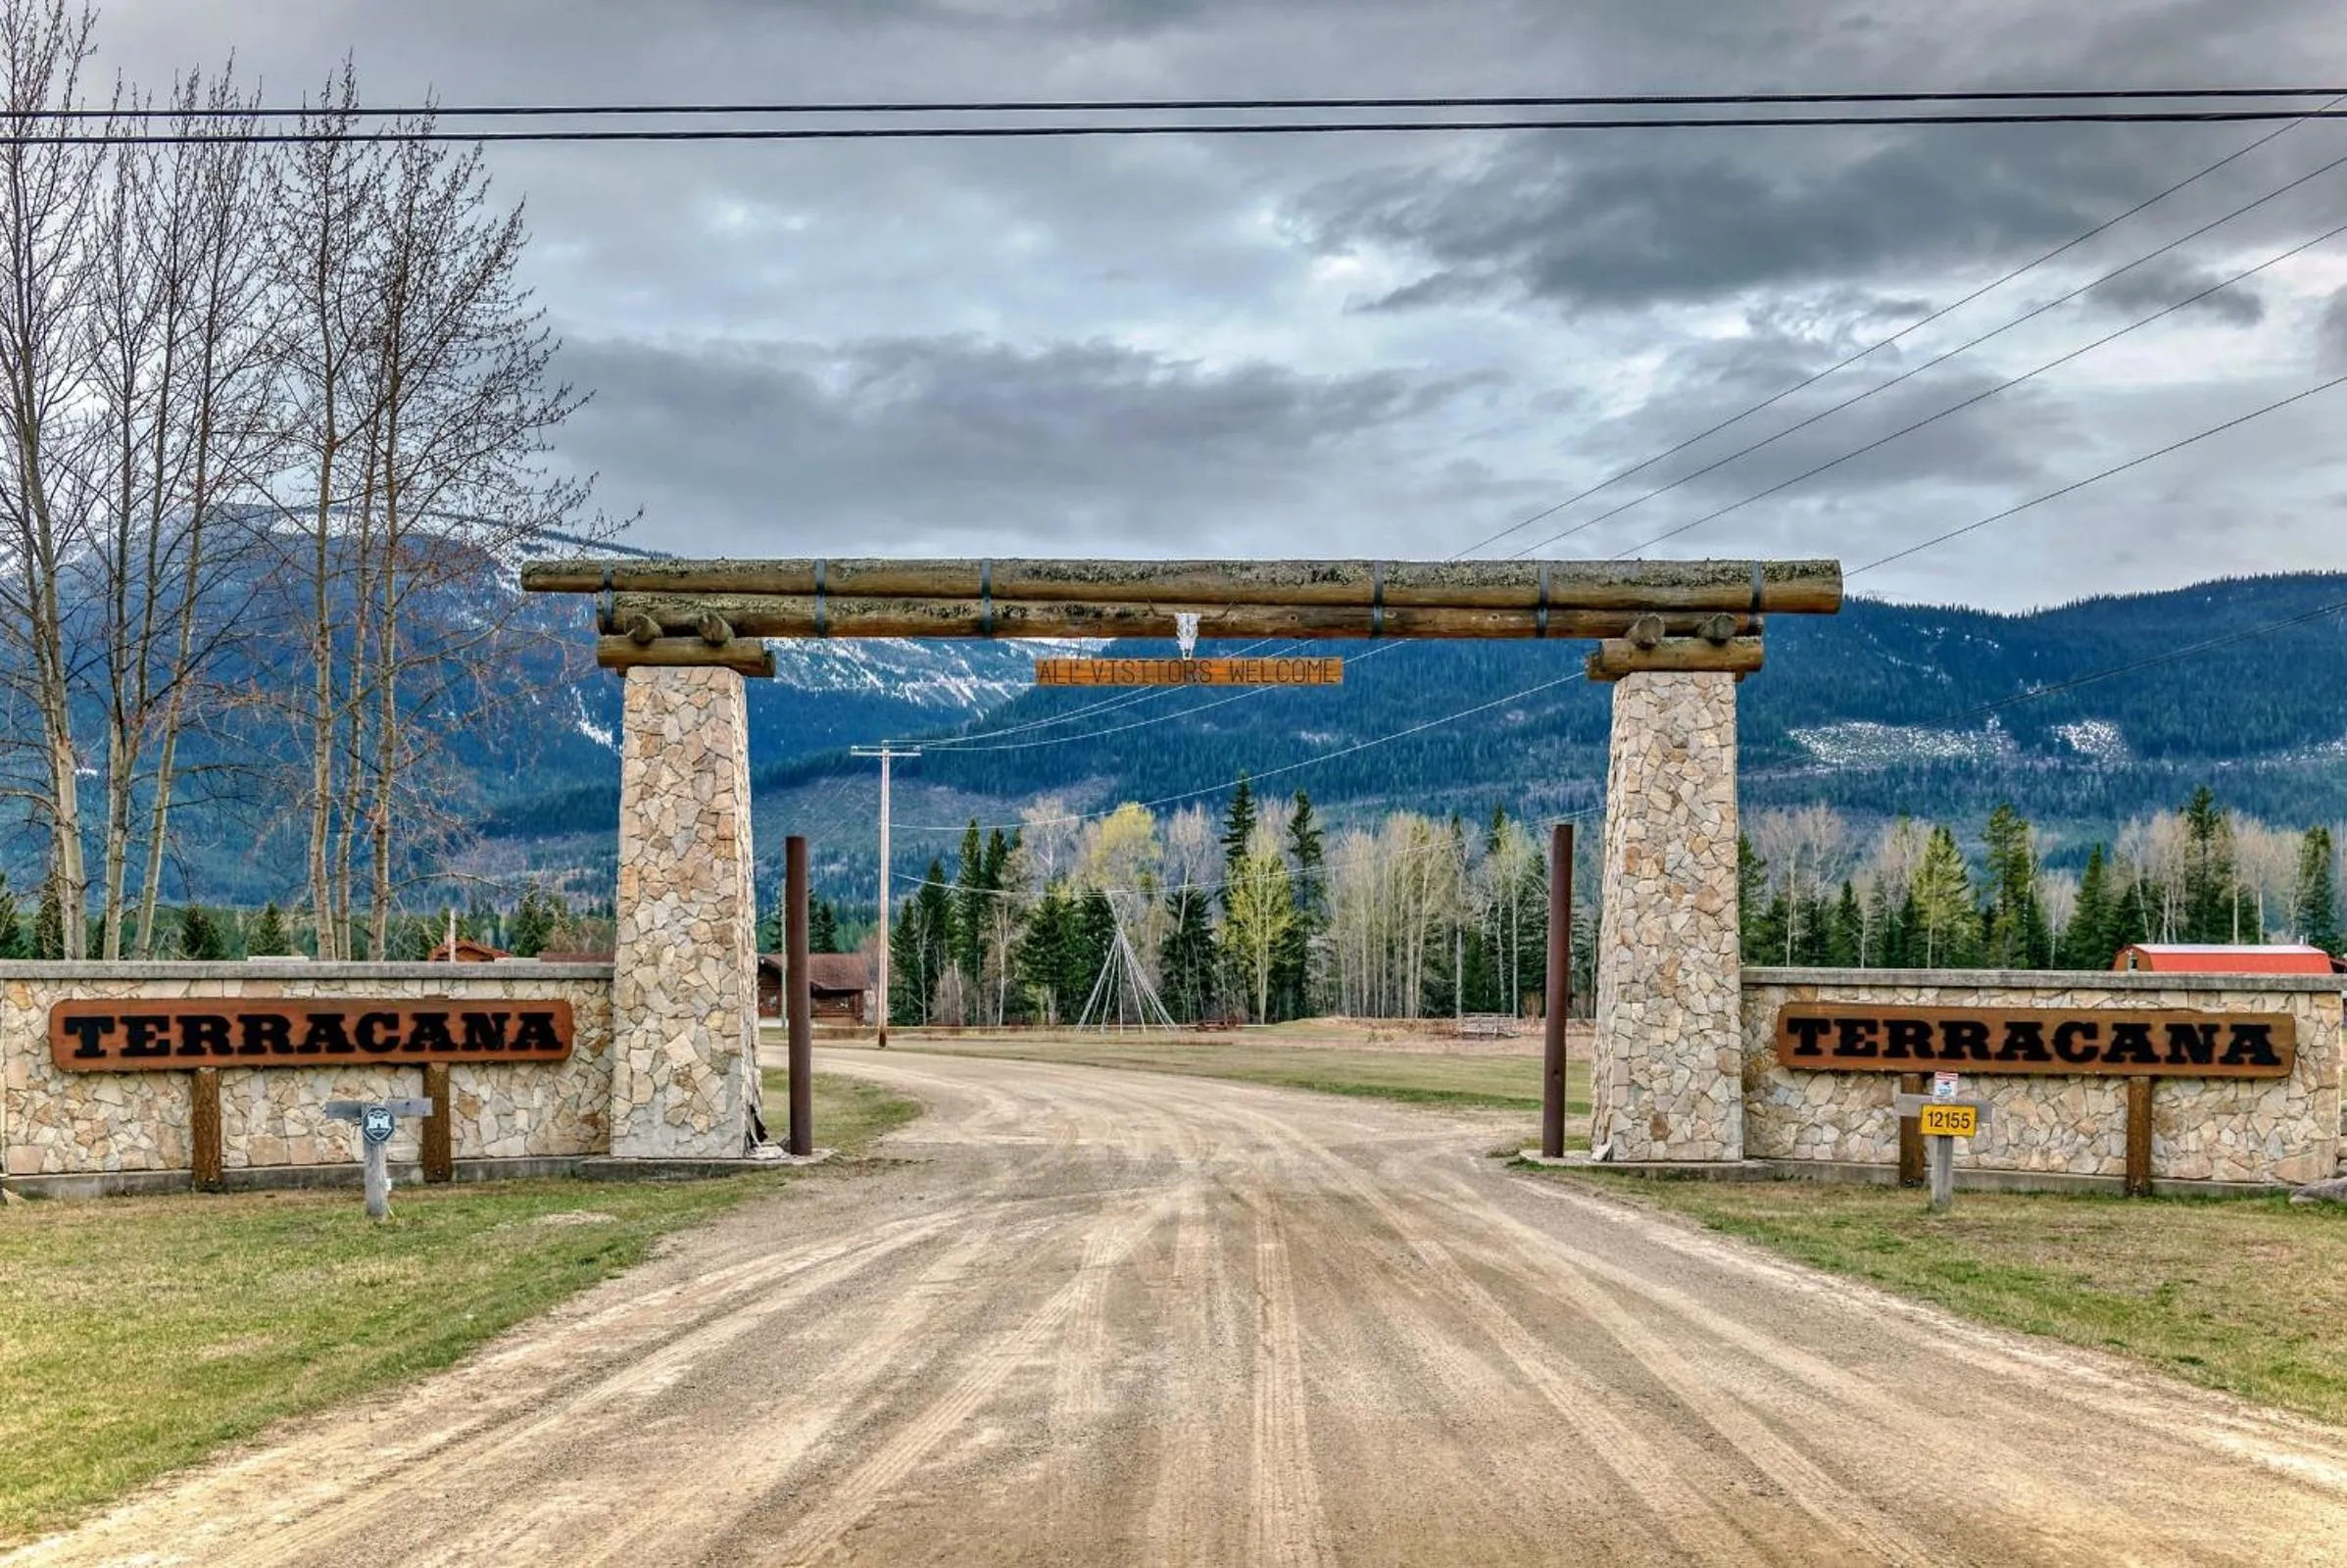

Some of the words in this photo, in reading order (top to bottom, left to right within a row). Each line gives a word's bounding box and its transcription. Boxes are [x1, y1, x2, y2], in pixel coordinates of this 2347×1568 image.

[1039, 660, 1079, 684] ALL
[1092, 659, 1213, 683] VISITORS
[1229, 659, 1336, 684] WELCOME
[64, 1012, 563, 1058] TERRACANA
[1786, 1018, 2282, 1065] TERRACANA
[1927, 1111, 1972, 1129] 12155
